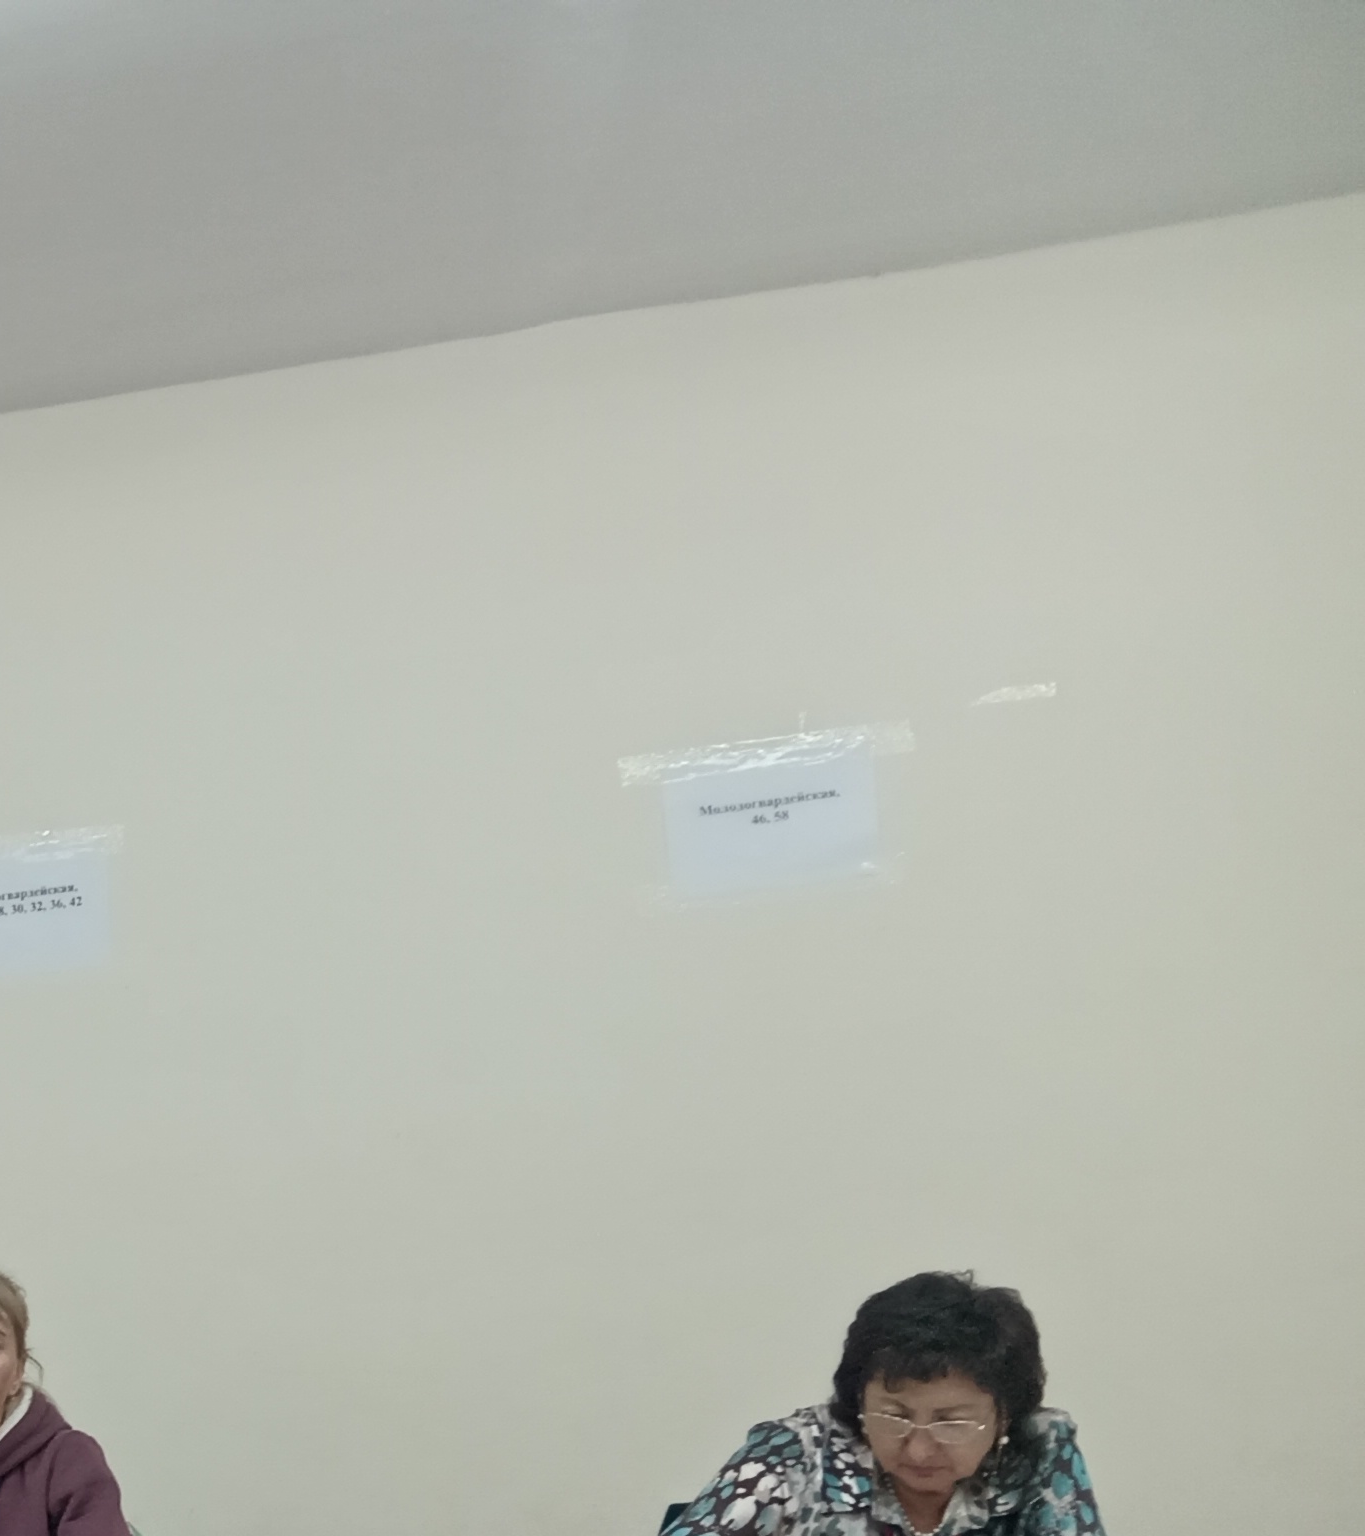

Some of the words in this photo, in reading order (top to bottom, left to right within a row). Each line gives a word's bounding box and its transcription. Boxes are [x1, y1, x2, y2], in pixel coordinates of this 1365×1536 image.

[751, 814, 771, 826] 46,
[773, 809, 789, 822] 58
[12, 904, 28, 915] 30,
[30, 901, 47, 912] 32,
[51, 899, 67, 910] 36,
[69, 896, 82, 906] 42
